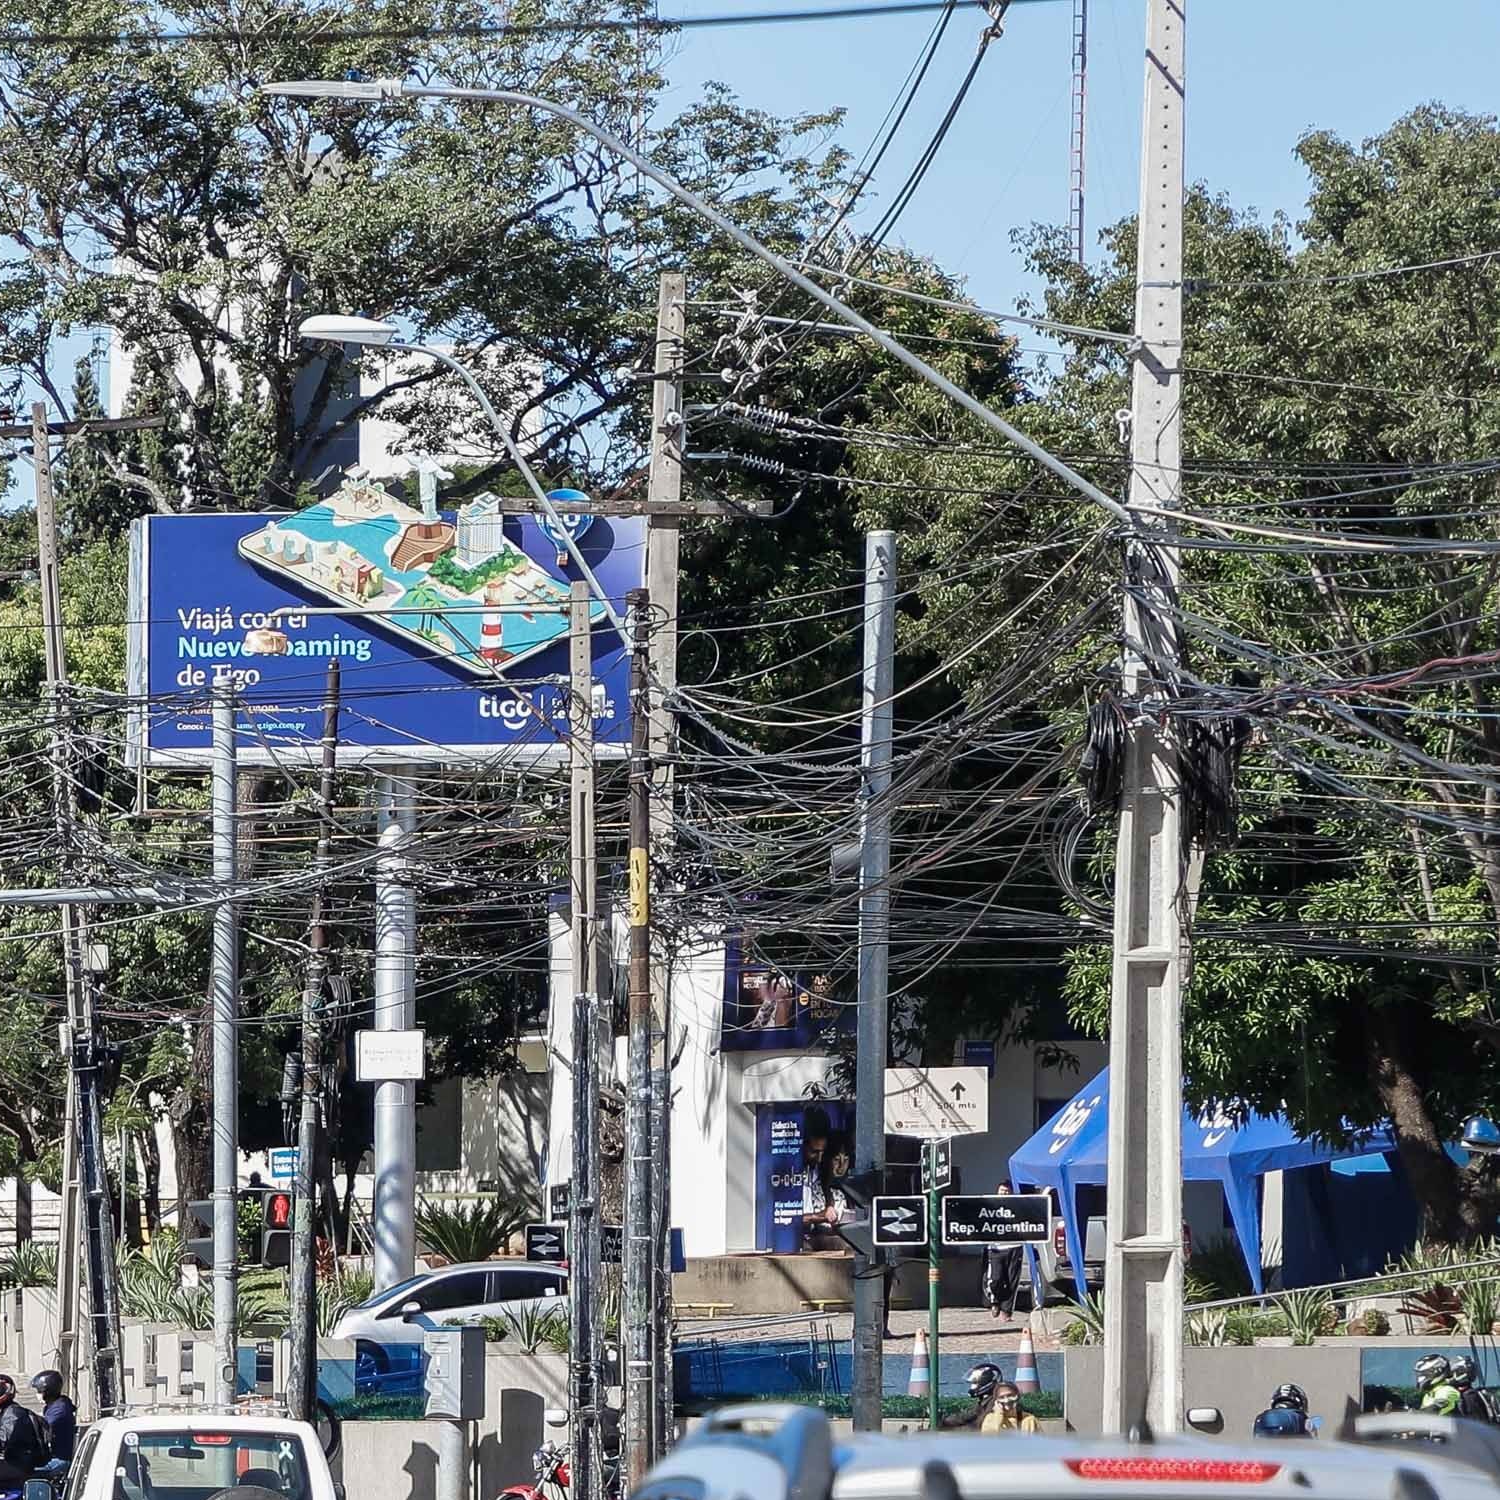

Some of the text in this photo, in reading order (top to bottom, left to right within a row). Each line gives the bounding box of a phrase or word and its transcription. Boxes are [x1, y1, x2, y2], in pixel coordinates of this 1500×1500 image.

[177, 606, 234, 635] Viajá
[263, 634, 372, 661] oaming
[177, 664, 260, 690] de Tigo
[978, 1207, 1016, 1218] Avda.
[950, 1222, 1045, 1236] Rep. Argentina
